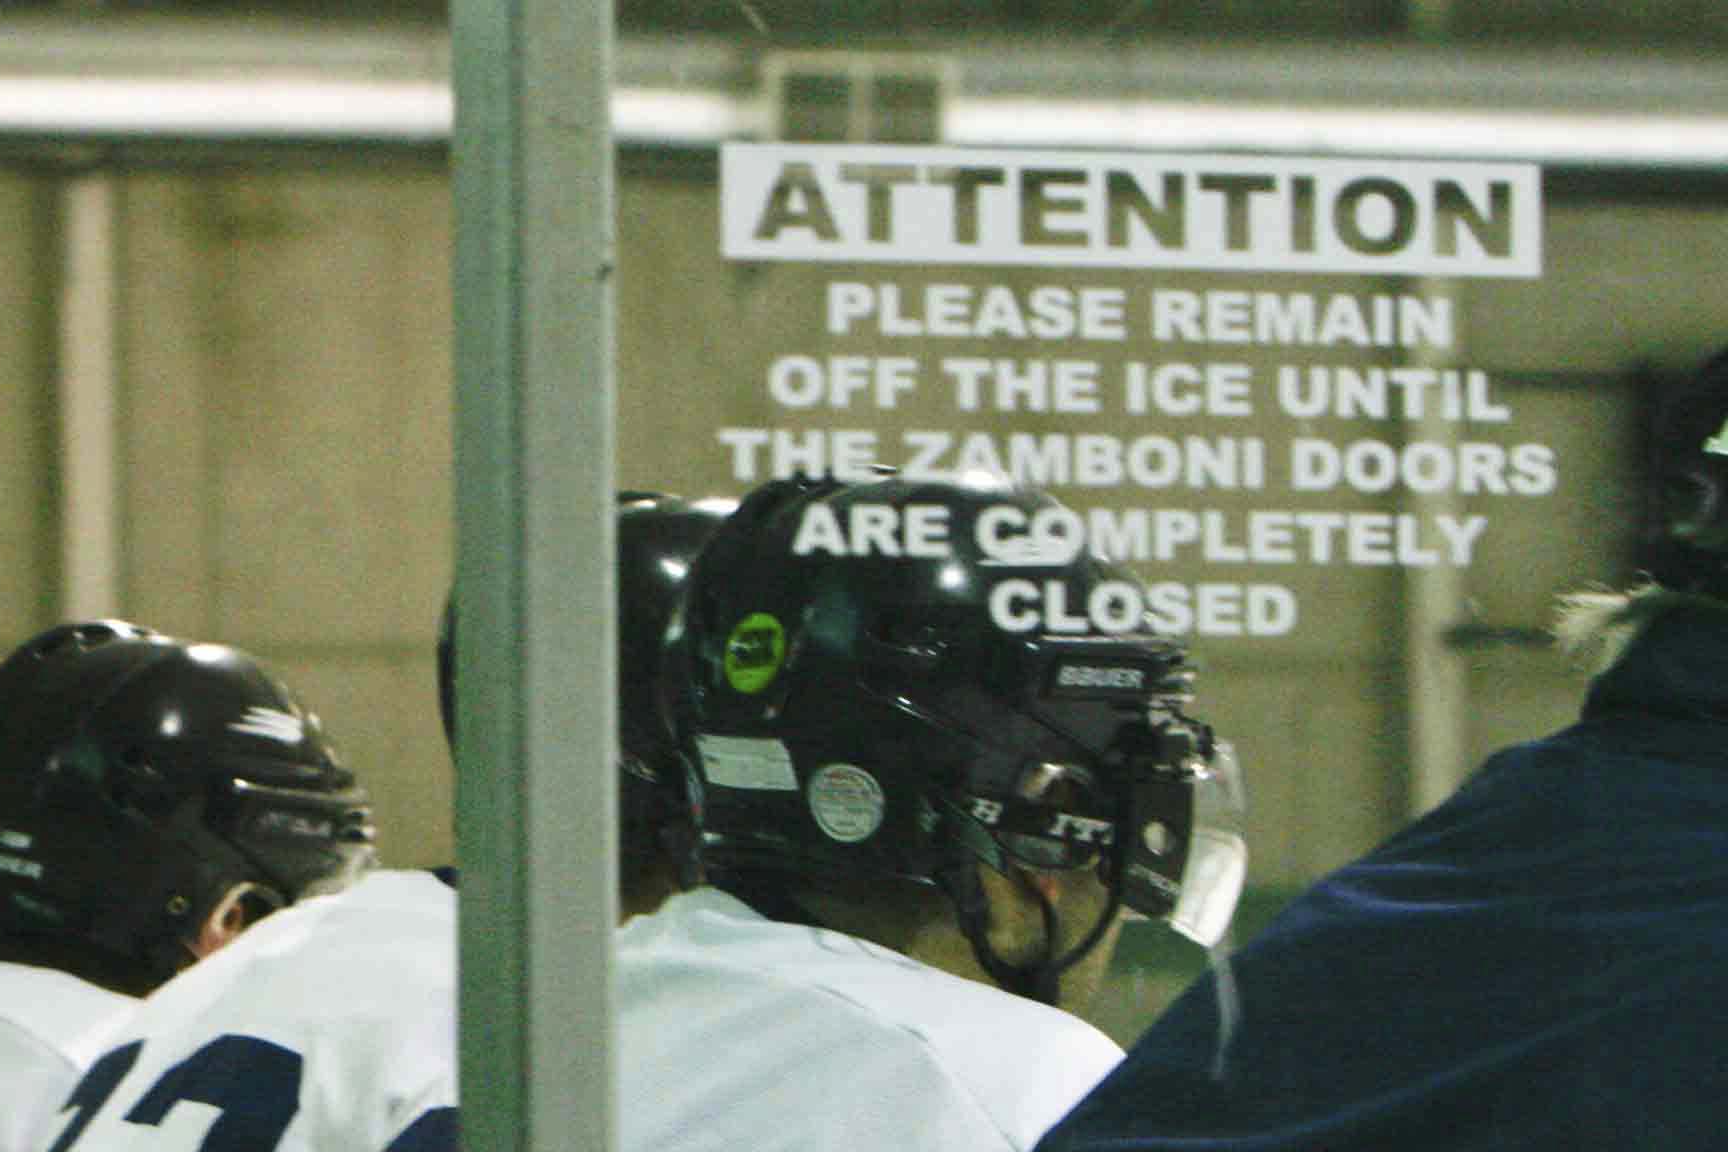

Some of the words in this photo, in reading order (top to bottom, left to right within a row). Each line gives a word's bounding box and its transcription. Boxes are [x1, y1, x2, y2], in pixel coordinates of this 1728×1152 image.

[753, 161, 1512, 258] ATTENTION
[829, 282, 1126, 341] PLEASE
[1152, 290, 1453, 348] REMAIN
[770, 358, 918, 409] OFF
[944, 360, 1100, 413] THE
[1126, 363, 1254, 416] ICE
[1278, 368, 1510, 421] UNTIL
[718, 429, 878, 480] THE
[904, 431, 1262, 487] ZAMBONI
[1292, 441, 1558, 494] DOORS
[792, 505, 950, 556] ARE
[977, 505, 1486, 566] COMPLETELY
[988, 581, 1296, 636] CLOSED
